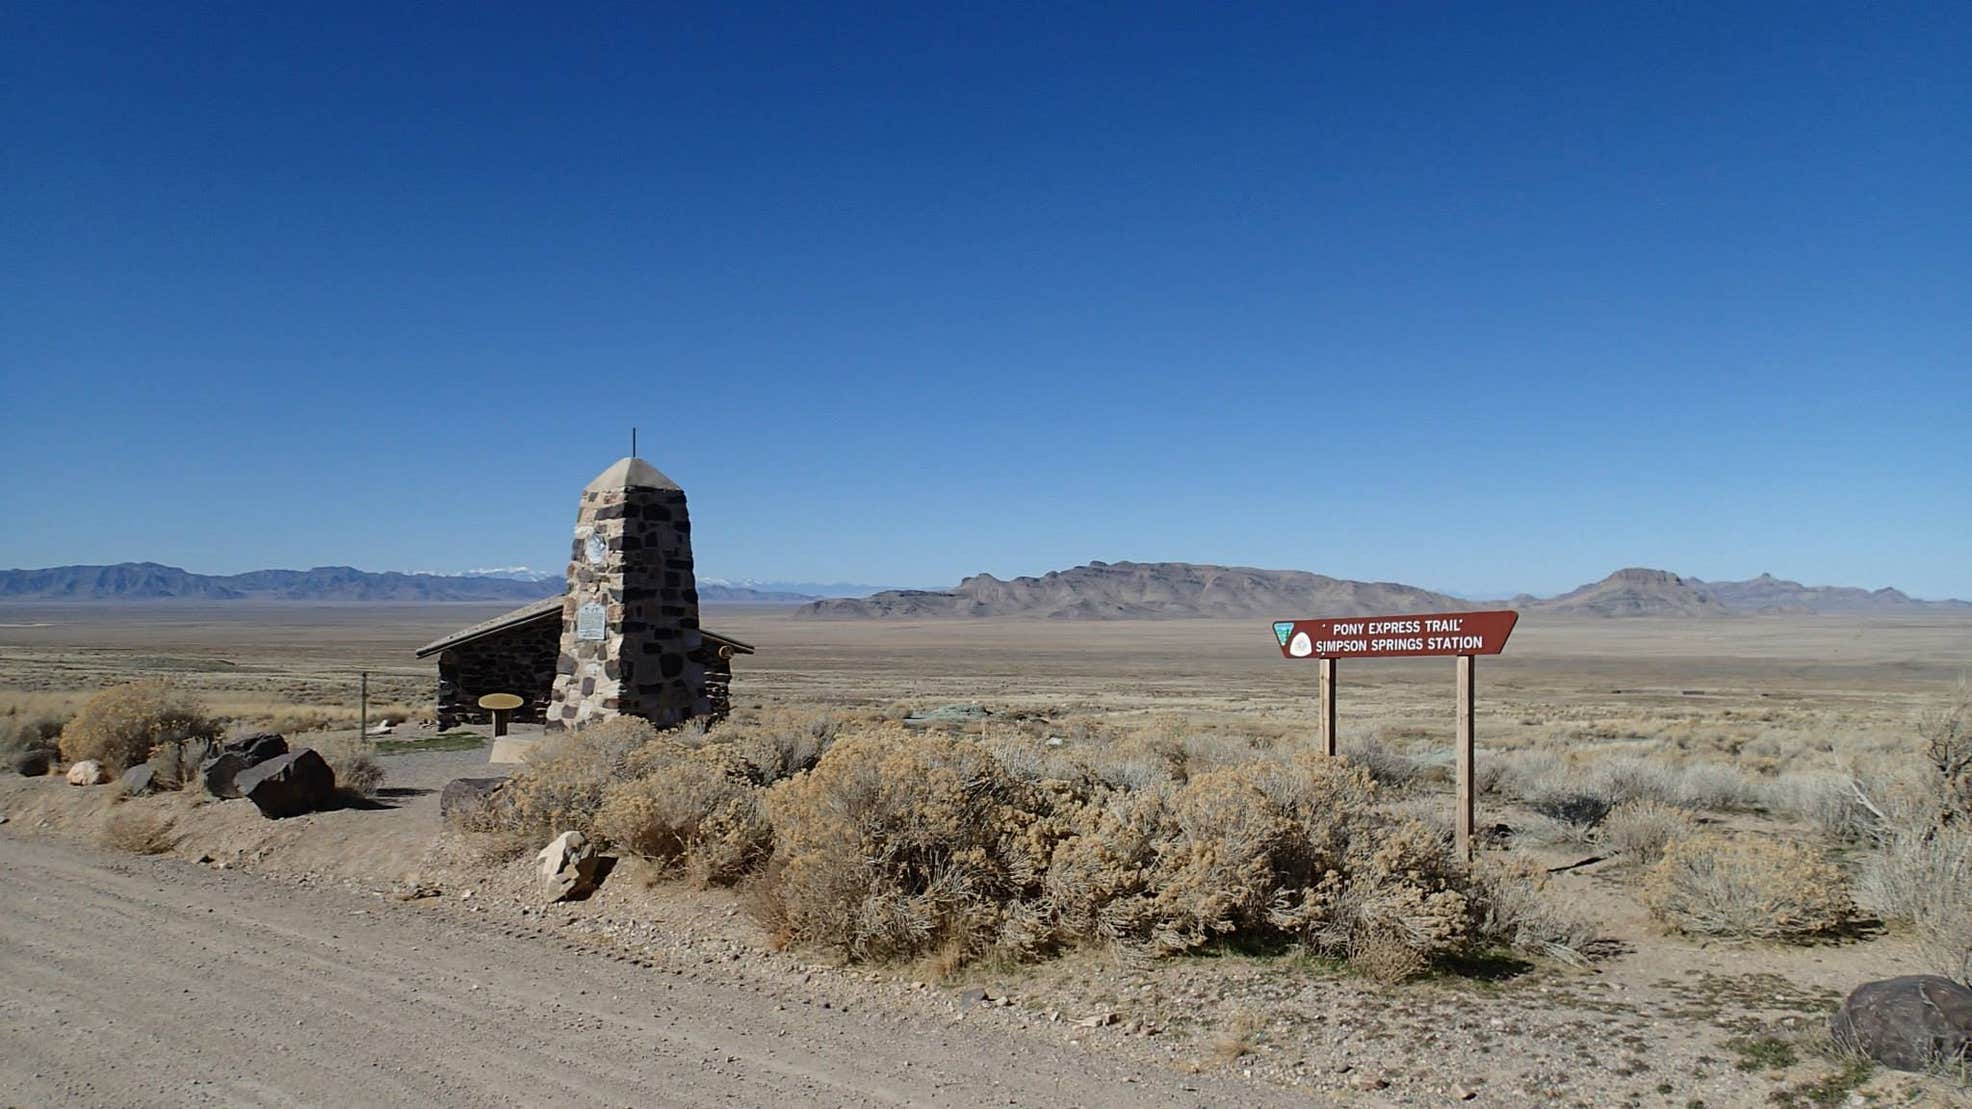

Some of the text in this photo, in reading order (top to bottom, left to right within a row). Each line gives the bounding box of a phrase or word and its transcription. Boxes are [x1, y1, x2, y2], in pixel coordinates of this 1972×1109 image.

[1333, 619, 1461, 636] PONY EXPRESS TRAIL
[1316, 636, 1483, 653] SIMPSON SPRINGS STATION
